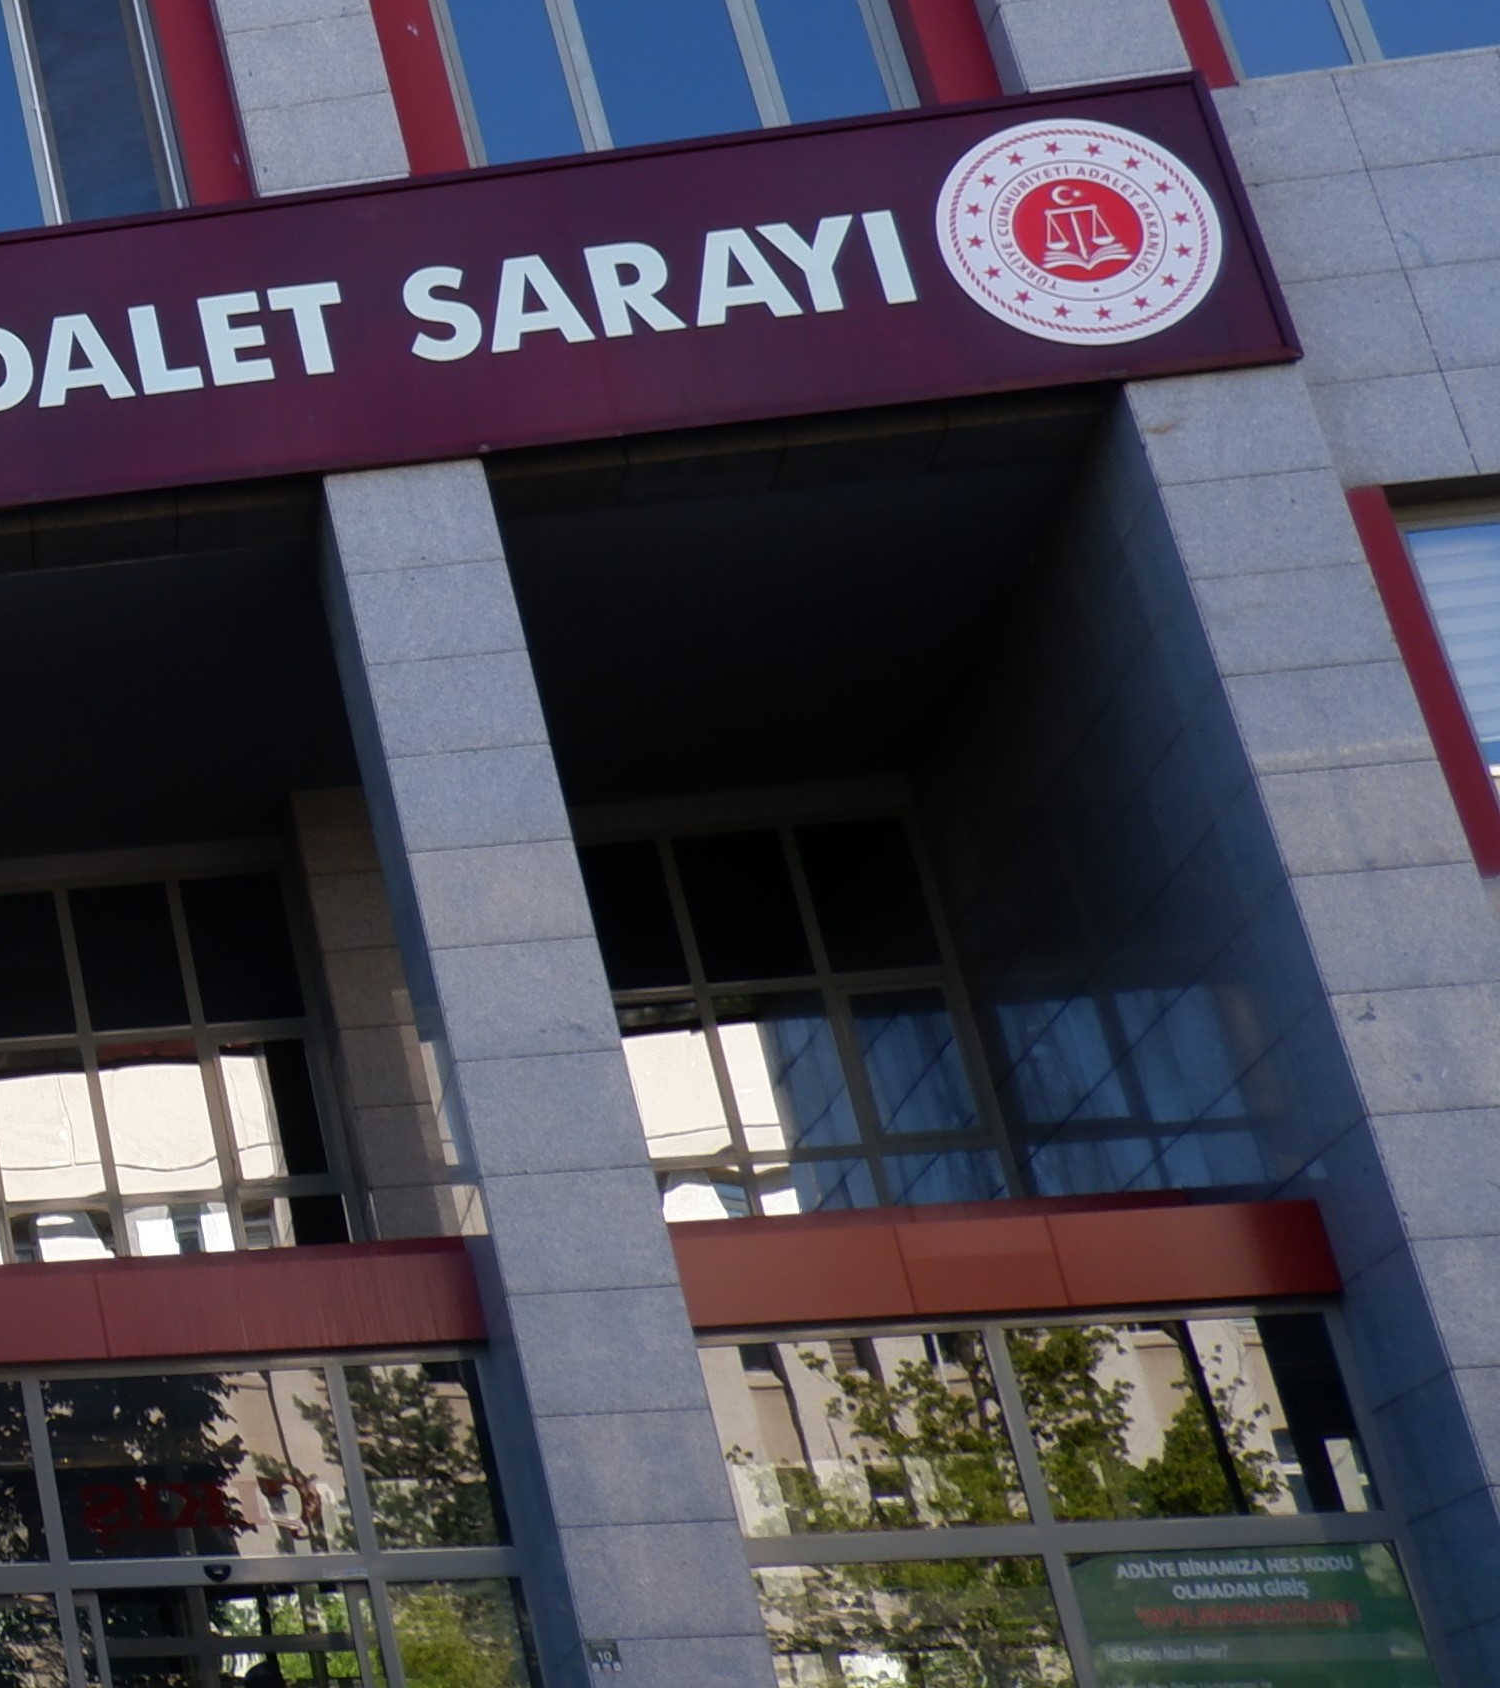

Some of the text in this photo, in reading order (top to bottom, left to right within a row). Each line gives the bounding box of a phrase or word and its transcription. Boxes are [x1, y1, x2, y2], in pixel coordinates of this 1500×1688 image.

[996, 164, 1160, 291] TÜRKİYE CUMHURİYETİ ADALET BAKANLIĞI
[401, 208, 918, 362] SARAYI
[1116, 1555, 1354, 1580] ADLİYE BİNAMIZA HES KODU
[1172, 1577, 1310, 1600] OLMADAN GİRİŞ
